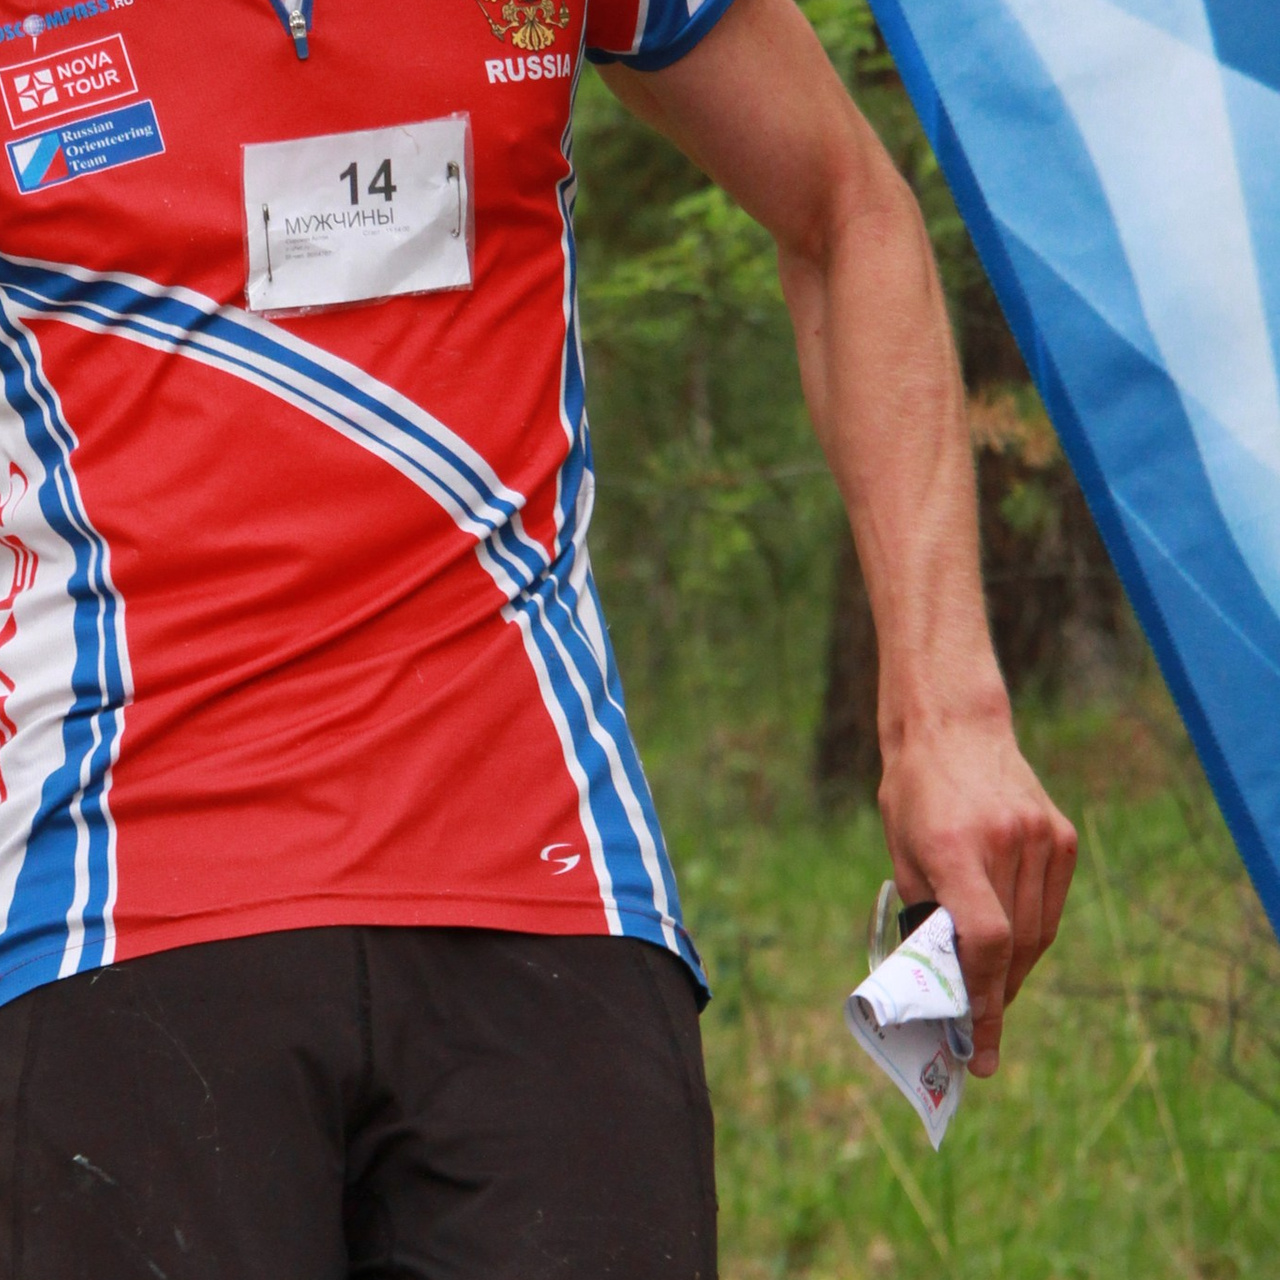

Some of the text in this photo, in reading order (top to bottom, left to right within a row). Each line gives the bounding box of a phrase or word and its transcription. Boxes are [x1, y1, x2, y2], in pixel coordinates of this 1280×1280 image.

[57, 51, 113, 80] NOVA
[485, 53, 571, 83] RUSSIA
[63, 69, 120, 98] TOUR
[61, 120, 114, 143] Russian
[65, 124, 154, 158] Orienteering
[69, 154, 107, 172] Team
[339, 159, 396, 205] 14
[284, 207, 394, 235] МУЖЧИНЫ
